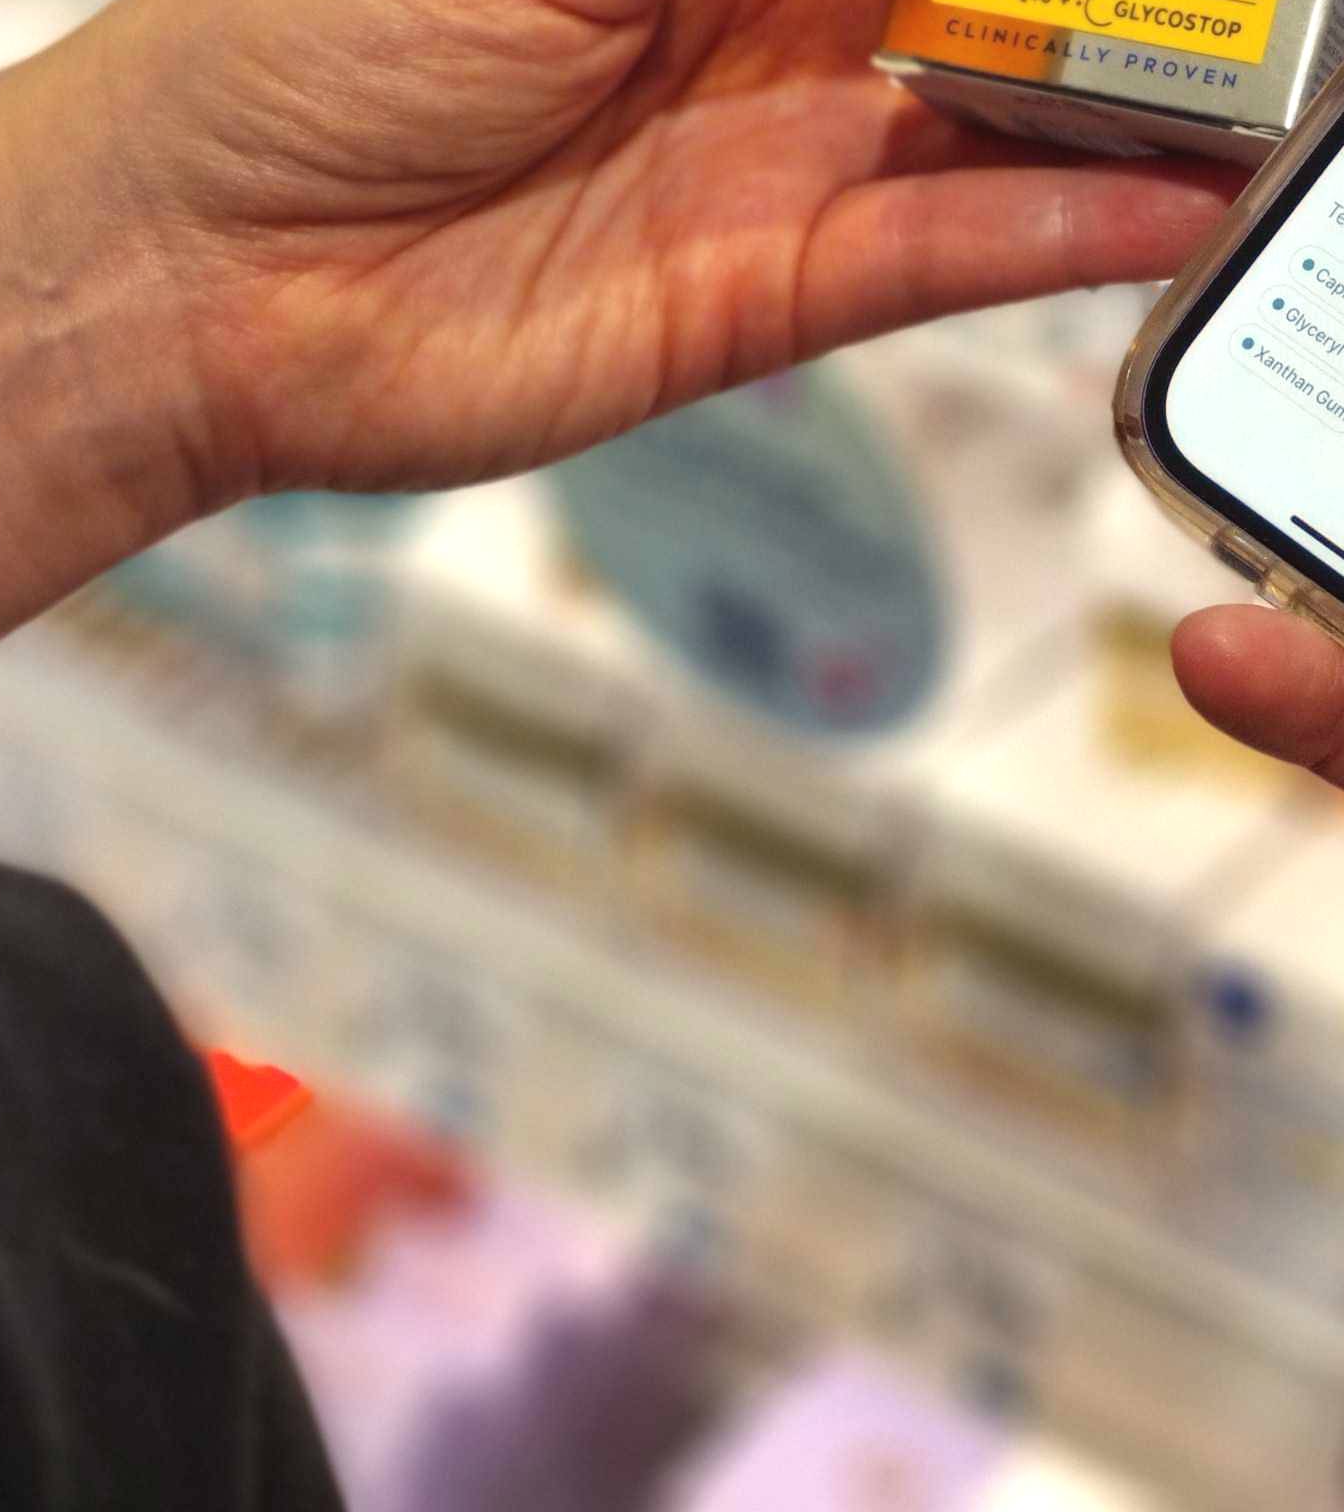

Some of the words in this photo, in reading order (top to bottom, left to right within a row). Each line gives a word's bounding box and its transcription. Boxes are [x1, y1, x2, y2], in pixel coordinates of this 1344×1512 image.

[1113, 0, 1242, 39] GLYCOSTOP
[945, 19, 1111, 63] CLINICALLY
[1125, 53, 1238, 88] PROVEN
[1253, 345, 1315, 396] Xanthan
